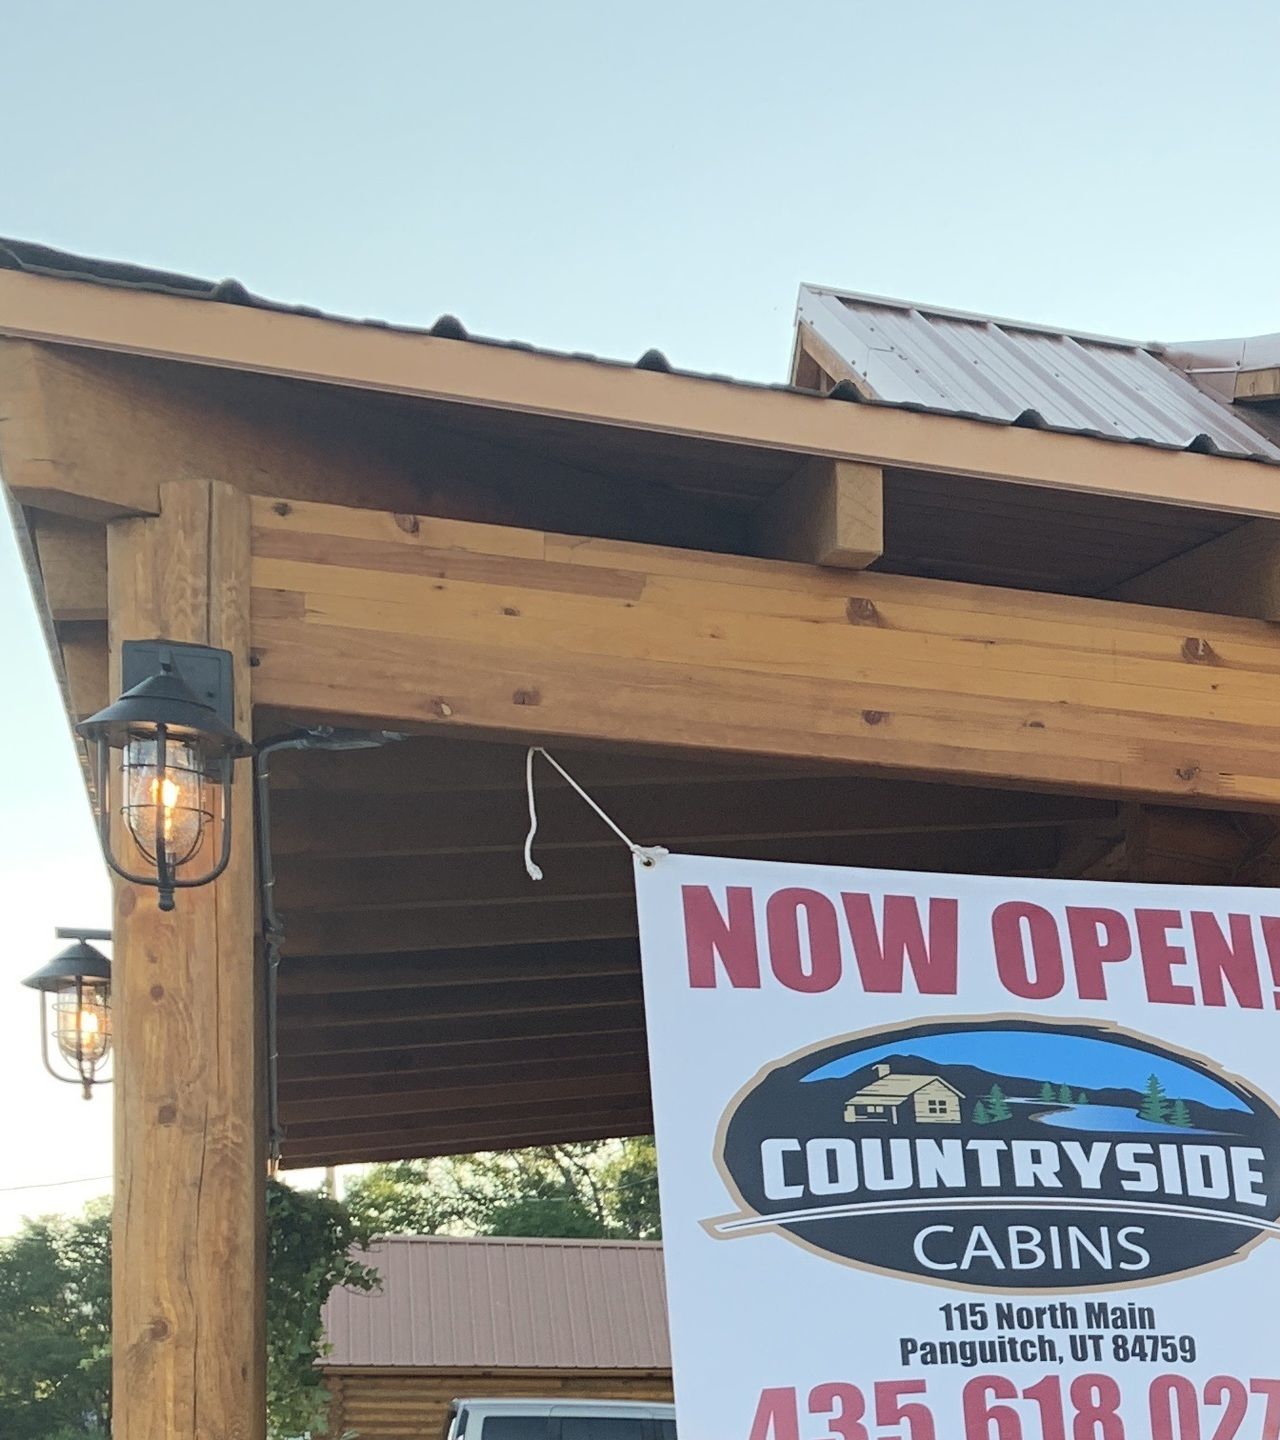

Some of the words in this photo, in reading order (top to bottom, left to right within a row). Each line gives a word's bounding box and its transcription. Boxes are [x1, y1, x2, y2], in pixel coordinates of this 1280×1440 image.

[681, 885, 958, 996] NOW
[760, 1138, 1268, 1206] COUNTRYSIDE
[913, 1225, 1151, 1270] CABINS
[939, 1302, 988, 1331] 115
[995, 1302, 1078, 1330] North
[1084, 1302, 1156, 1330] Main
[900, 1334, 1064, 1367] Panguitch,
[1069, 1335, 1104, 1362] UT
[1112, 1335, 1197, 1363] 84759
